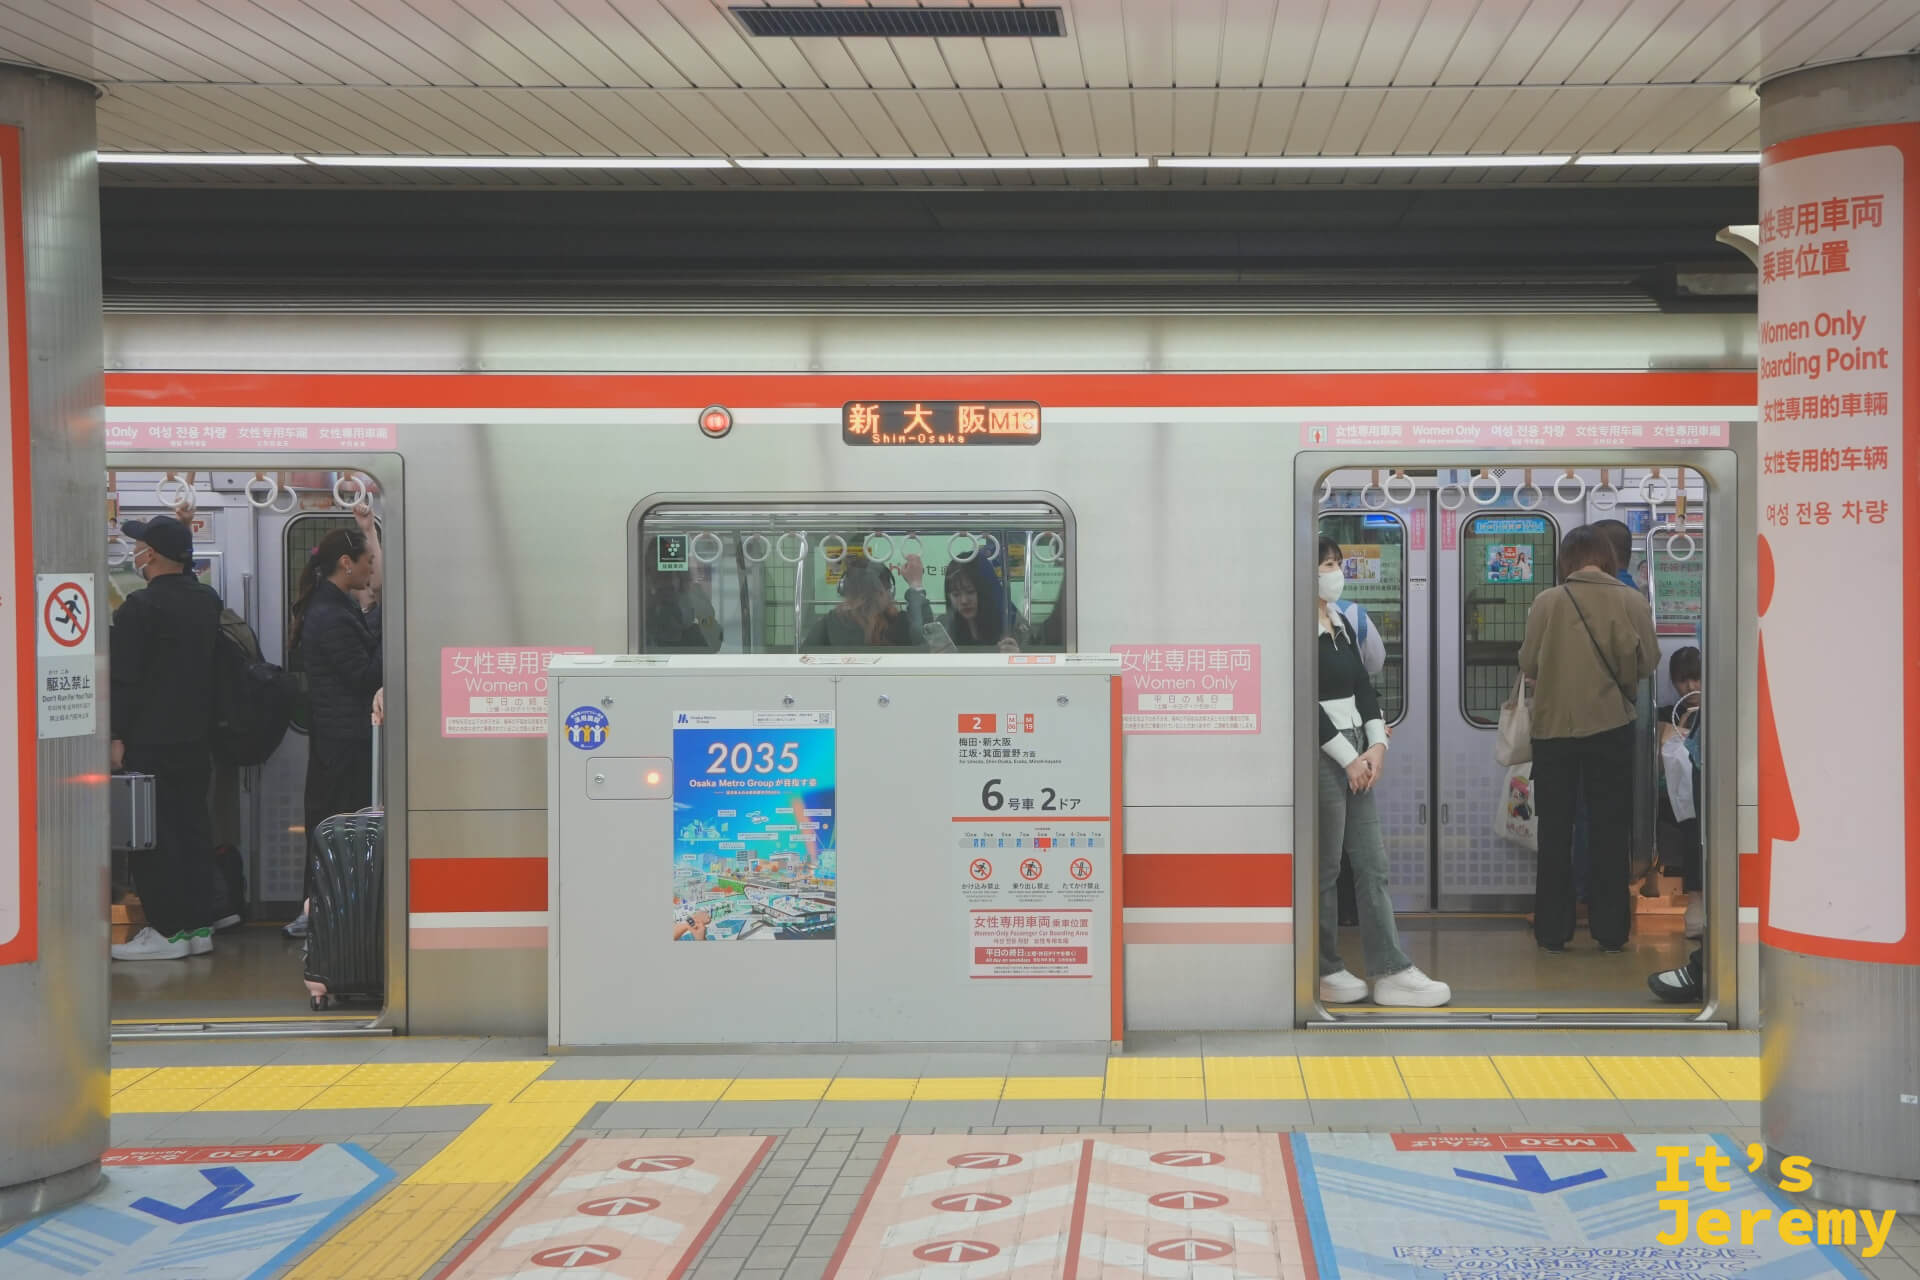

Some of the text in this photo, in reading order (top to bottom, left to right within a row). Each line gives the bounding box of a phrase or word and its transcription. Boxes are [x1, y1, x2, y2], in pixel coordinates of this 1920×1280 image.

[1760, 194, 1885, 246] 性専用車両
[1762, 240, 1851, 286] 乗車位置
[1760, 308, 1867, 345] Women Only
[1826, 345, 1889, 373] Point
[1763, 391, 1889, 424] 女性專用的車輛
[848, 402, 987, 435] 新大阪
[111, 425, 139, 439] Only
[871, 433, 966, 444] Shin-Osaka
[1412, 424, 1481, 440] Women Only
[1763, 445, 1889, 475] 女性专用的车辆
[1766, 499, 1889, 527] 여성 전용 차량
[1121, 649, 1251, 672] 女性専用車両
[465, 677, 529, 692] Women
[1134, 674, 1238, 690] Women Only
[972, 716, 982, 730] 2
[959, 737, 1012, 747] 梅田・新大阪
[706, 742, 799, 774] 2035
[689, 779, 717, 788] Osaka
[718, 779, 745, 788] Metro
[747, 779, 774, 789] Group
[974, 915, 1051, 929] 女性専用車両
[1520, 1138, 1596, 1147] M20
[209, 1149, 284, 1159] M20
